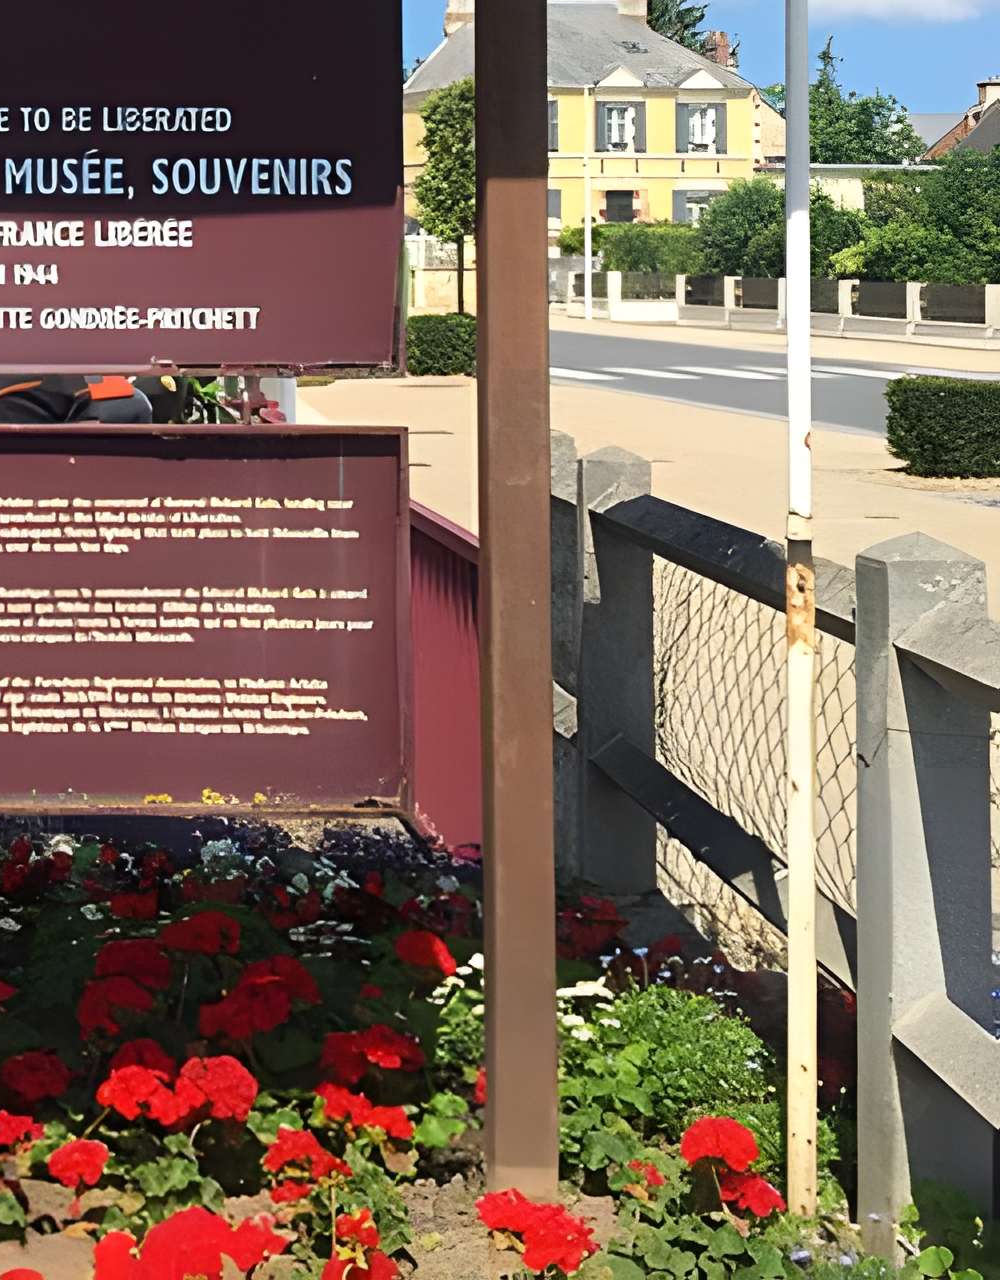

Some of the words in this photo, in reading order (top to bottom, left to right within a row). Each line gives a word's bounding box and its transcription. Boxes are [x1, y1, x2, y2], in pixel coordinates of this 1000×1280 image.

[19, 106, 51, 133] TO
[61, 106, 92, 132] BE
[102, 106, 232, 133] LIBERATED
[4, 148, 134, 200] MUSÉE,
[151, 157, 352, 197] SOUVENIRS
